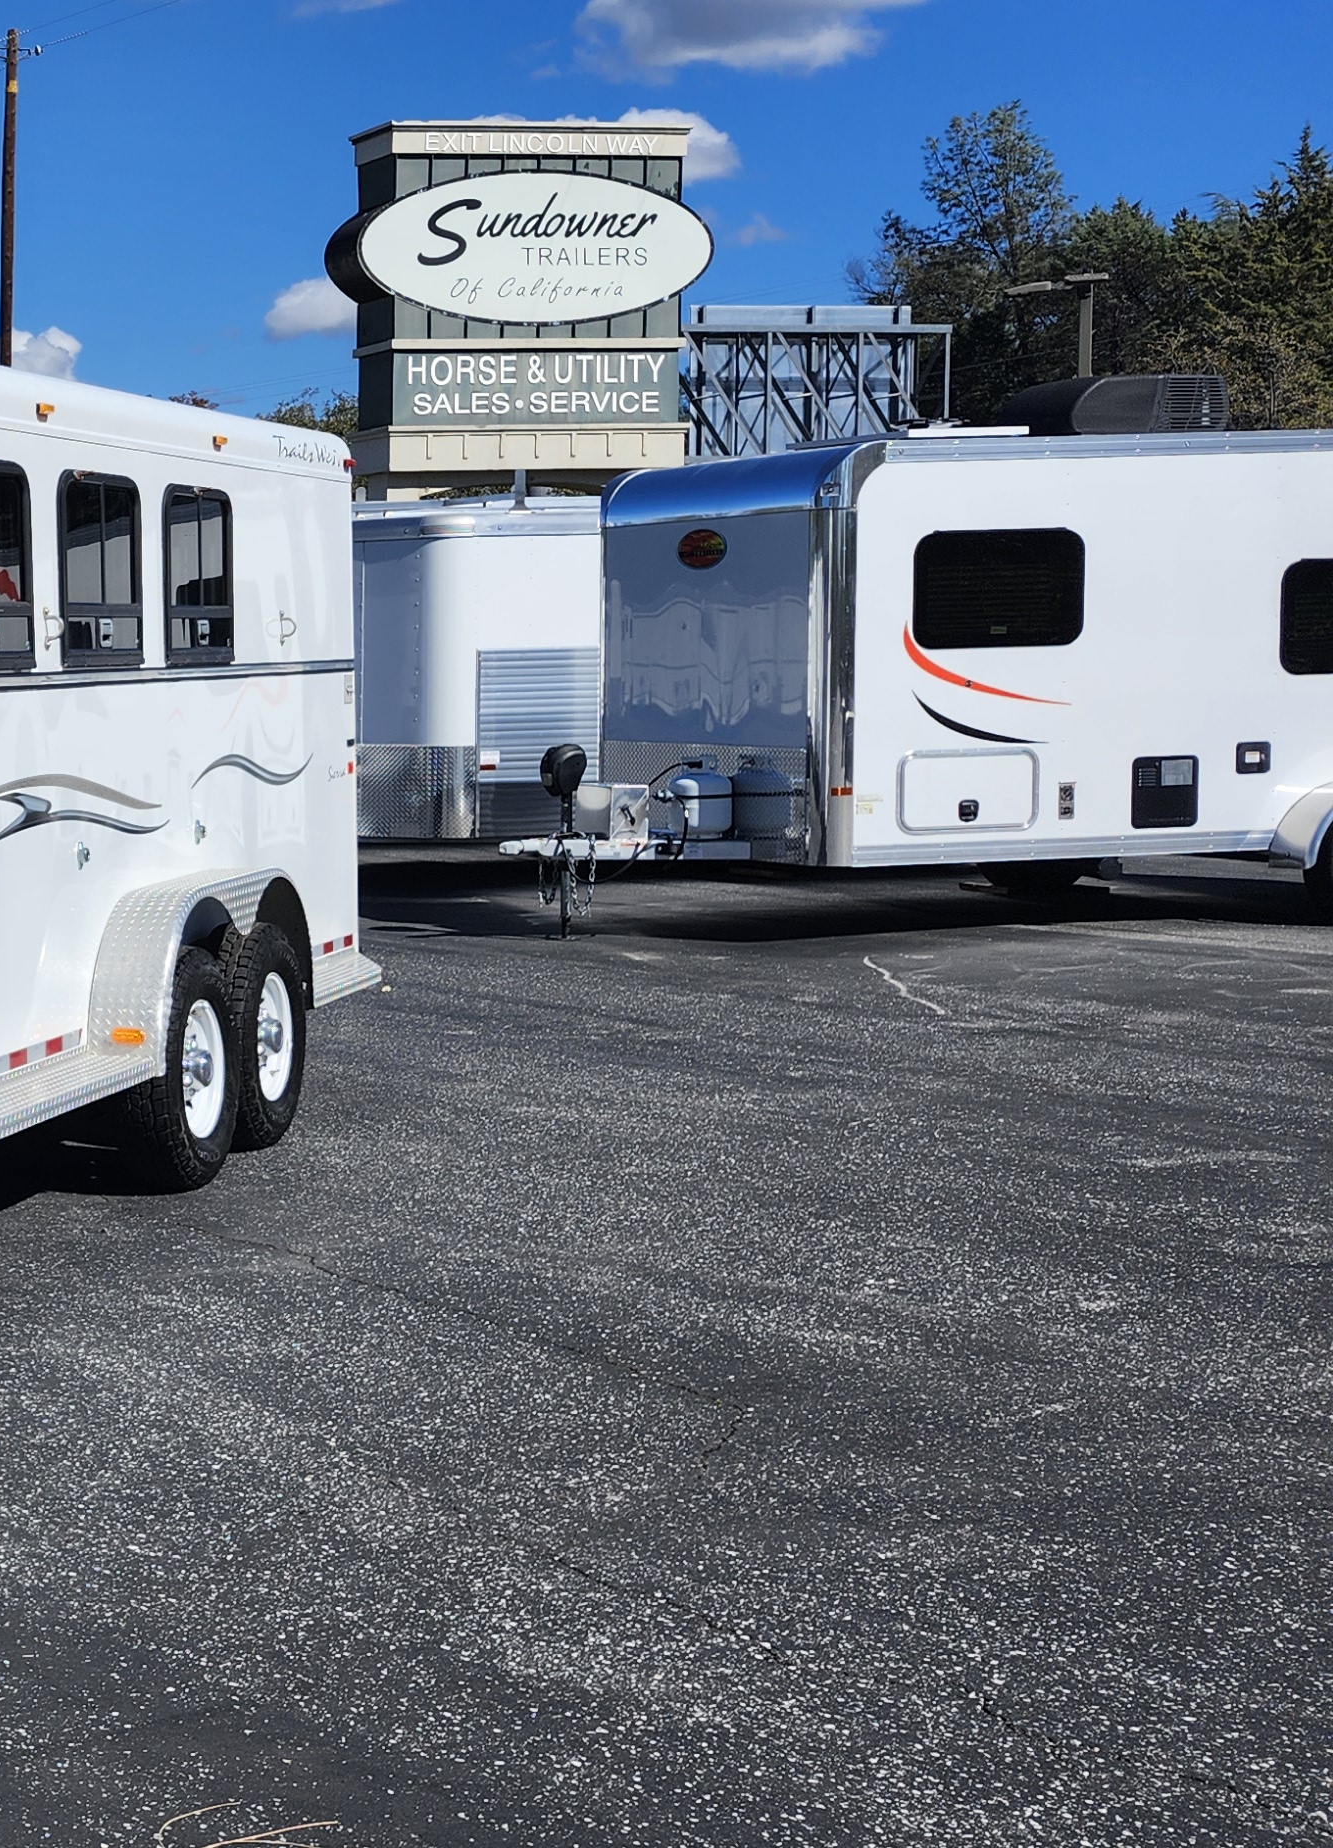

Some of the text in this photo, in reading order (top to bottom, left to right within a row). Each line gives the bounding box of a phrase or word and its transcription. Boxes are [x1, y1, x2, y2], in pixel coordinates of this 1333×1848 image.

[424, 132, 659, 155] EXIT LINCOLN WAY
[417, 191, 659, 266] Sundowner
[521, 247, 648, 266] TRAILERS
[450, 276, 623, 304] Of California
[407, 354, 665, 386] HORSE & UTILITY
[272, 435, 313, 463] Trails
